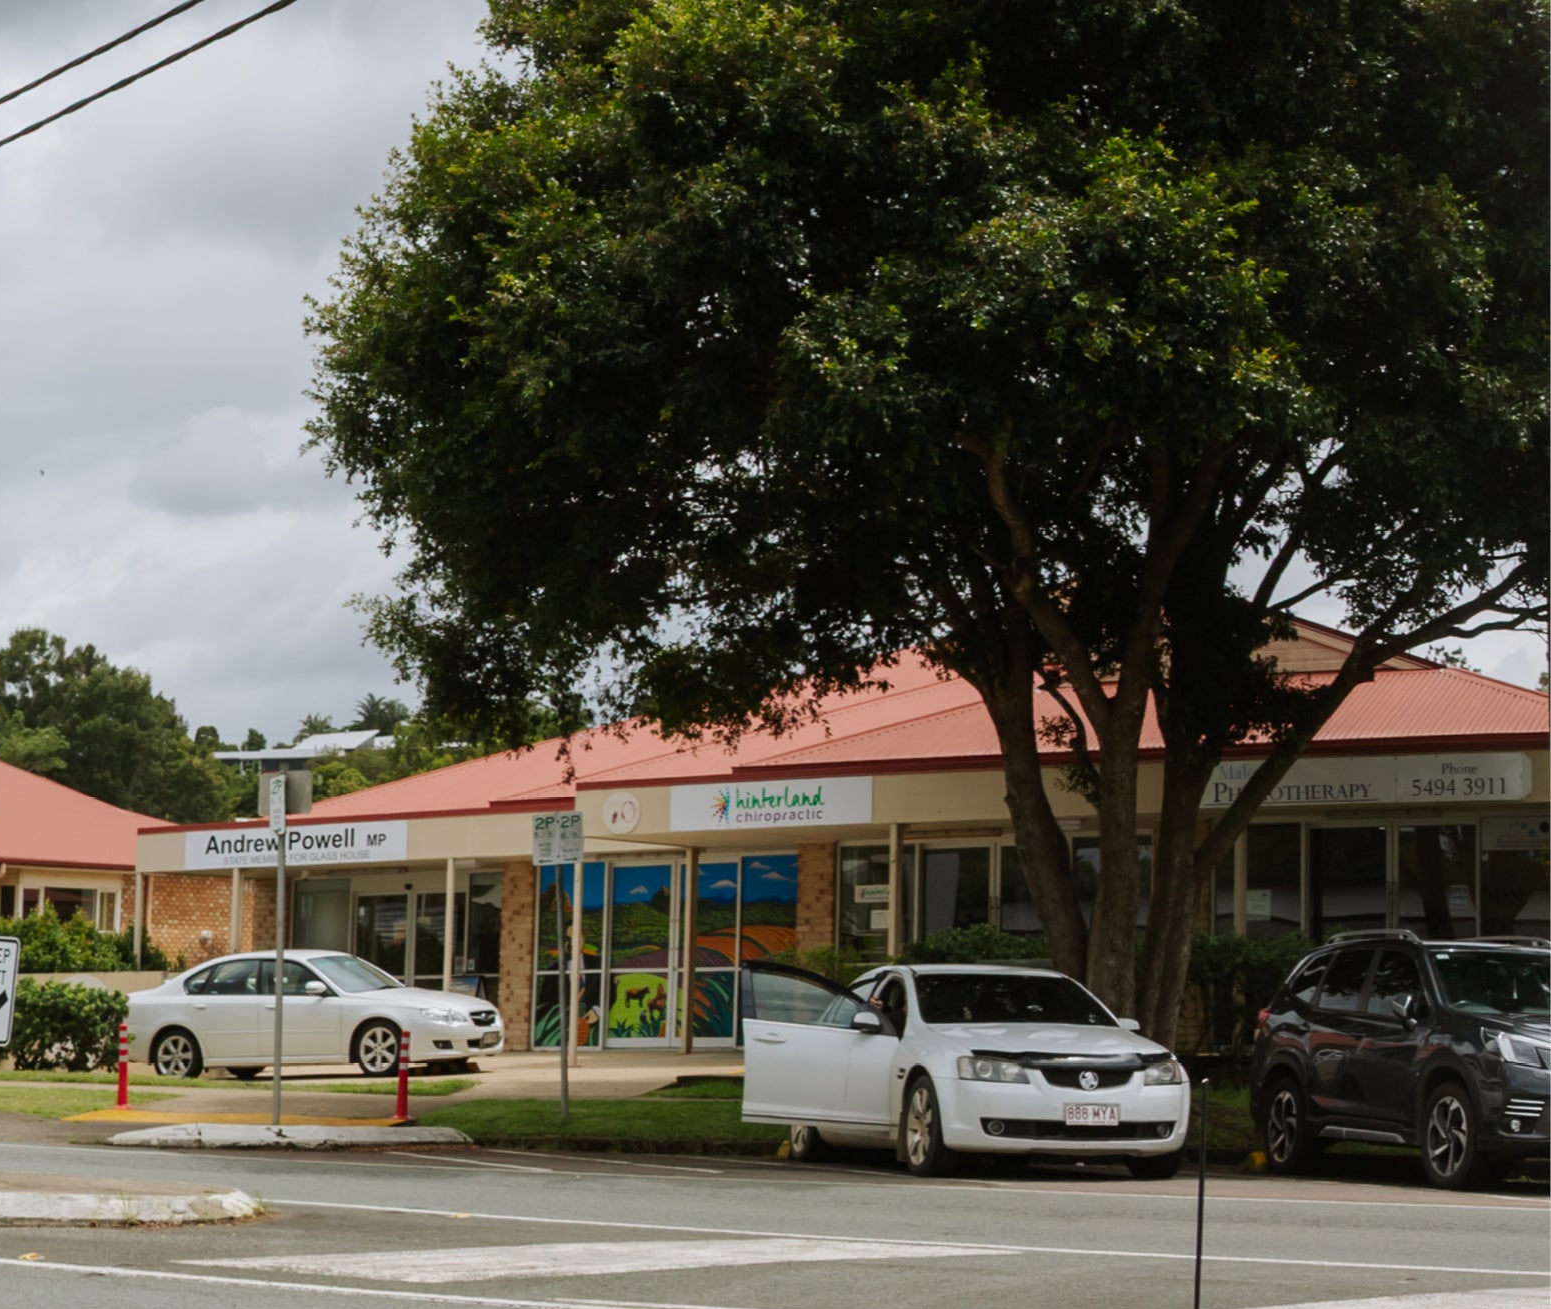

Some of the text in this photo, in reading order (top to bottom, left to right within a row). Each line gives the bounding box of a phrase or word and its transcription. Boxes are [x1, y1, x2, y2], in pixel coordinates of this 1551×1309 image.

[1441, 762, 1478, 775] Phone
[1411, 777, 1506, 797] 5494 3911
[735, 785, 825, 809] hinterland
[535, 816, 555, 830] 2P
[560, 814, 581, 828] 2P
[736, 808, 823, 823] chiropractic
[205, 828, 386, 855] Andrew Powell MP
[223, 855, 249, 866] STATE
[289, 852, 307, 862] FOR
[309, 851, 338, 861] GLASS
[340, 850, 371, 860] HOUSE
[1067, 1105, 1116, 1120] 888 MYA
